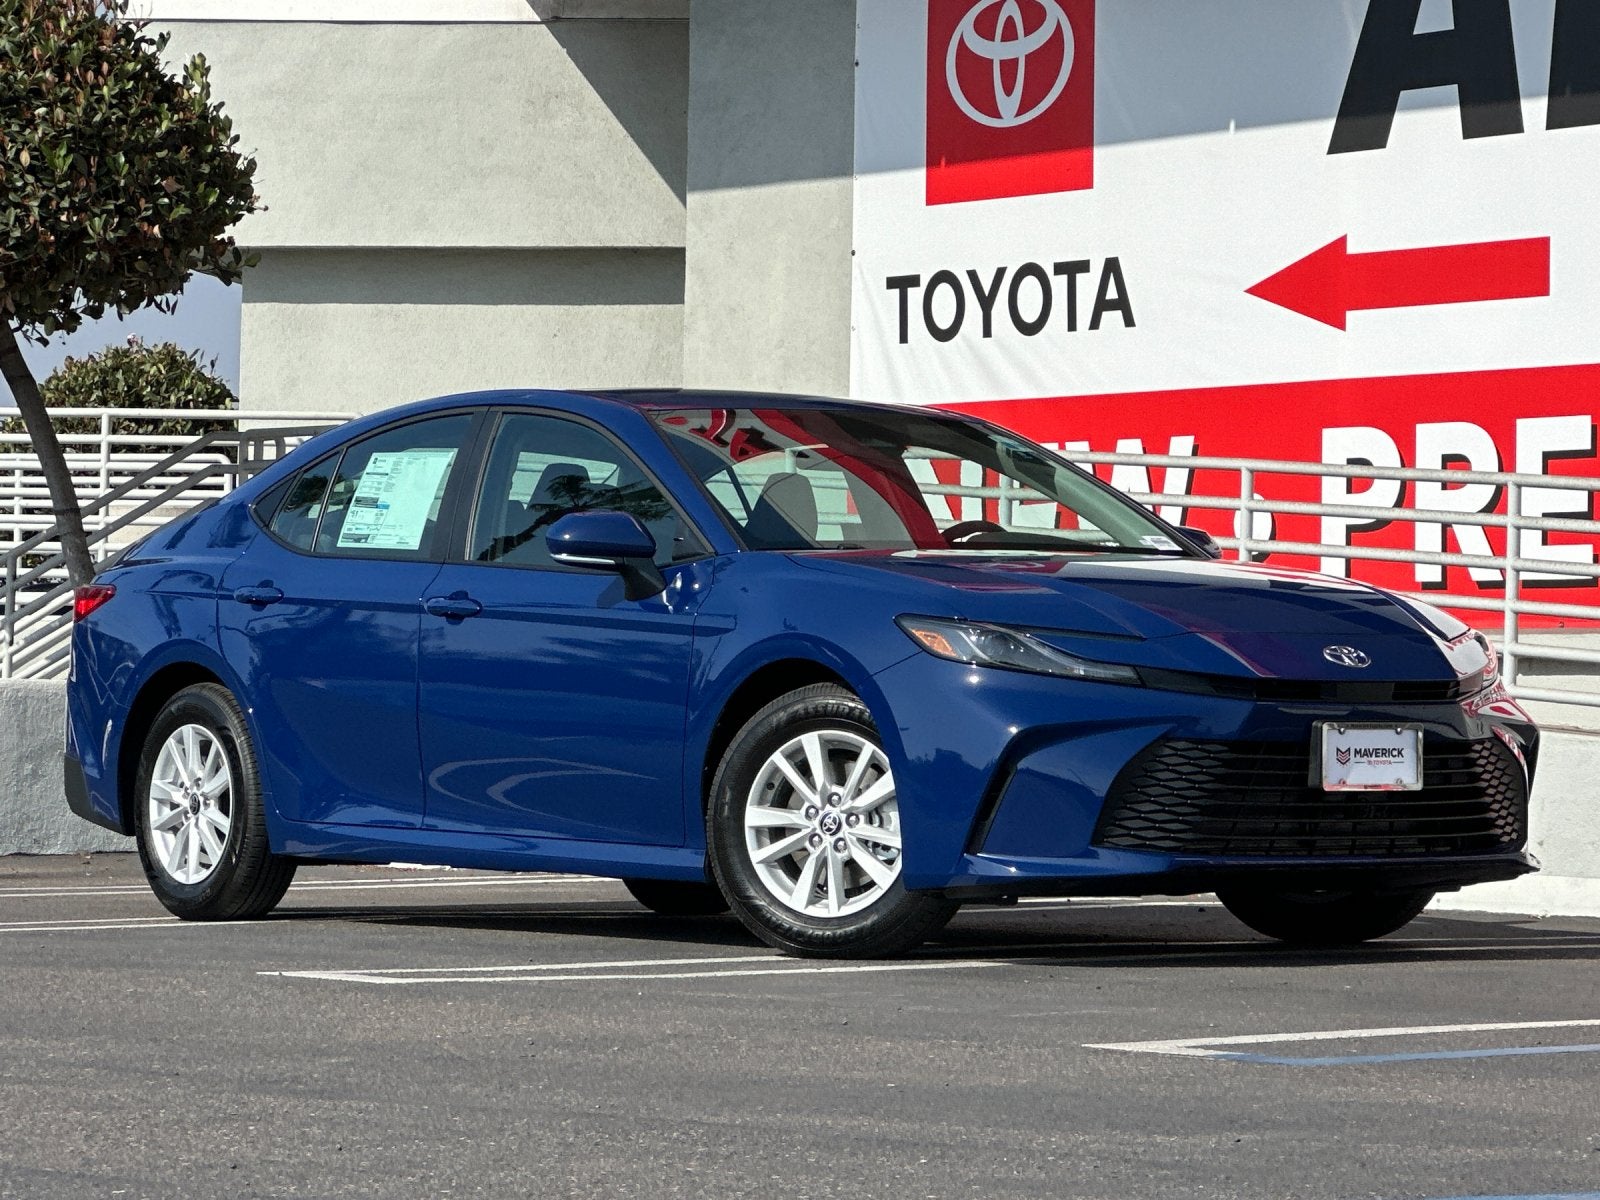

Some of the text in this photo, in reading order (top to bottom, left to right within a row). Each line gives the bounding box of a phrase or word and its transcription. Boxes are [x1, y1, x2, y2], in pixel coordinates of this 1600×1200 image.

[886, 257, 1136, 344] TOYOTA
[1319, 415, 1598, 588] PRE
[1354, 747, 1404, 758] MAVERICK
